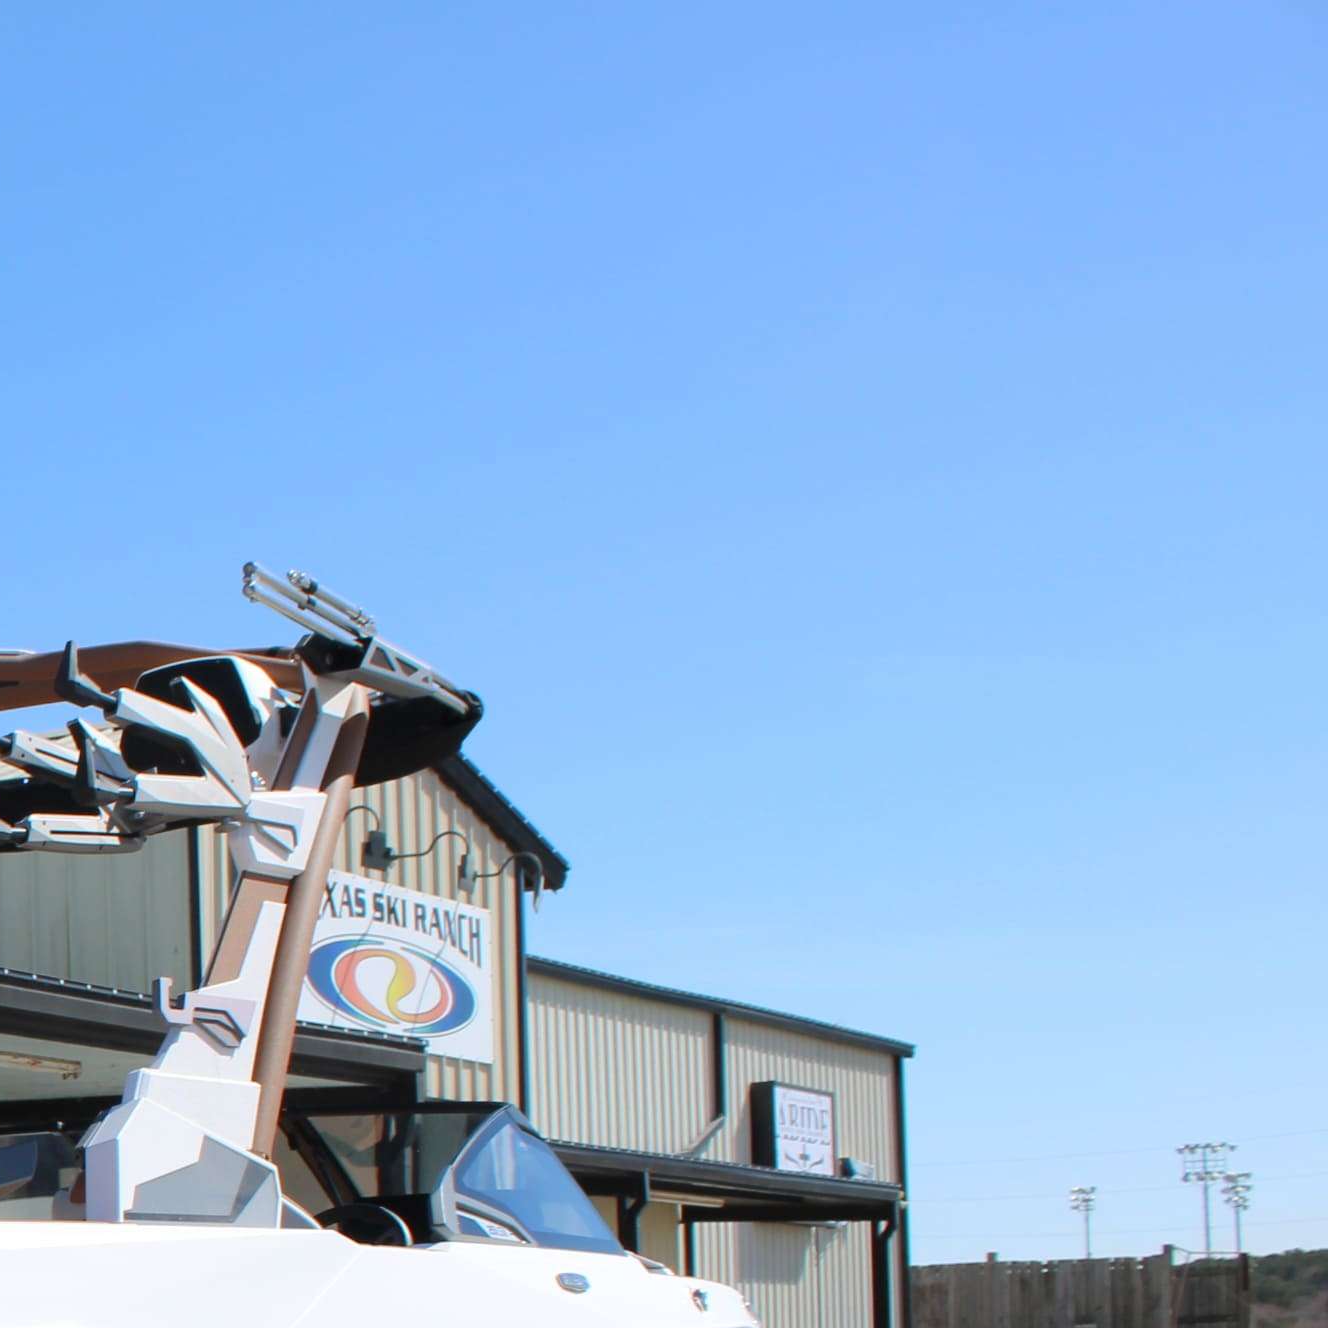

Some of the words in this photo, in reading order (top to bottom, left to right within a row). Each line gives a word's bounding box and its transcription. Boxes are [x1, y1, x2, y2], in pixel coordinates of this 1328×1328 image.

[318, 880, 366, 918] XAS
[372, 892, 407, 929] SKI
[414, 902, 482, 969] RANCH
